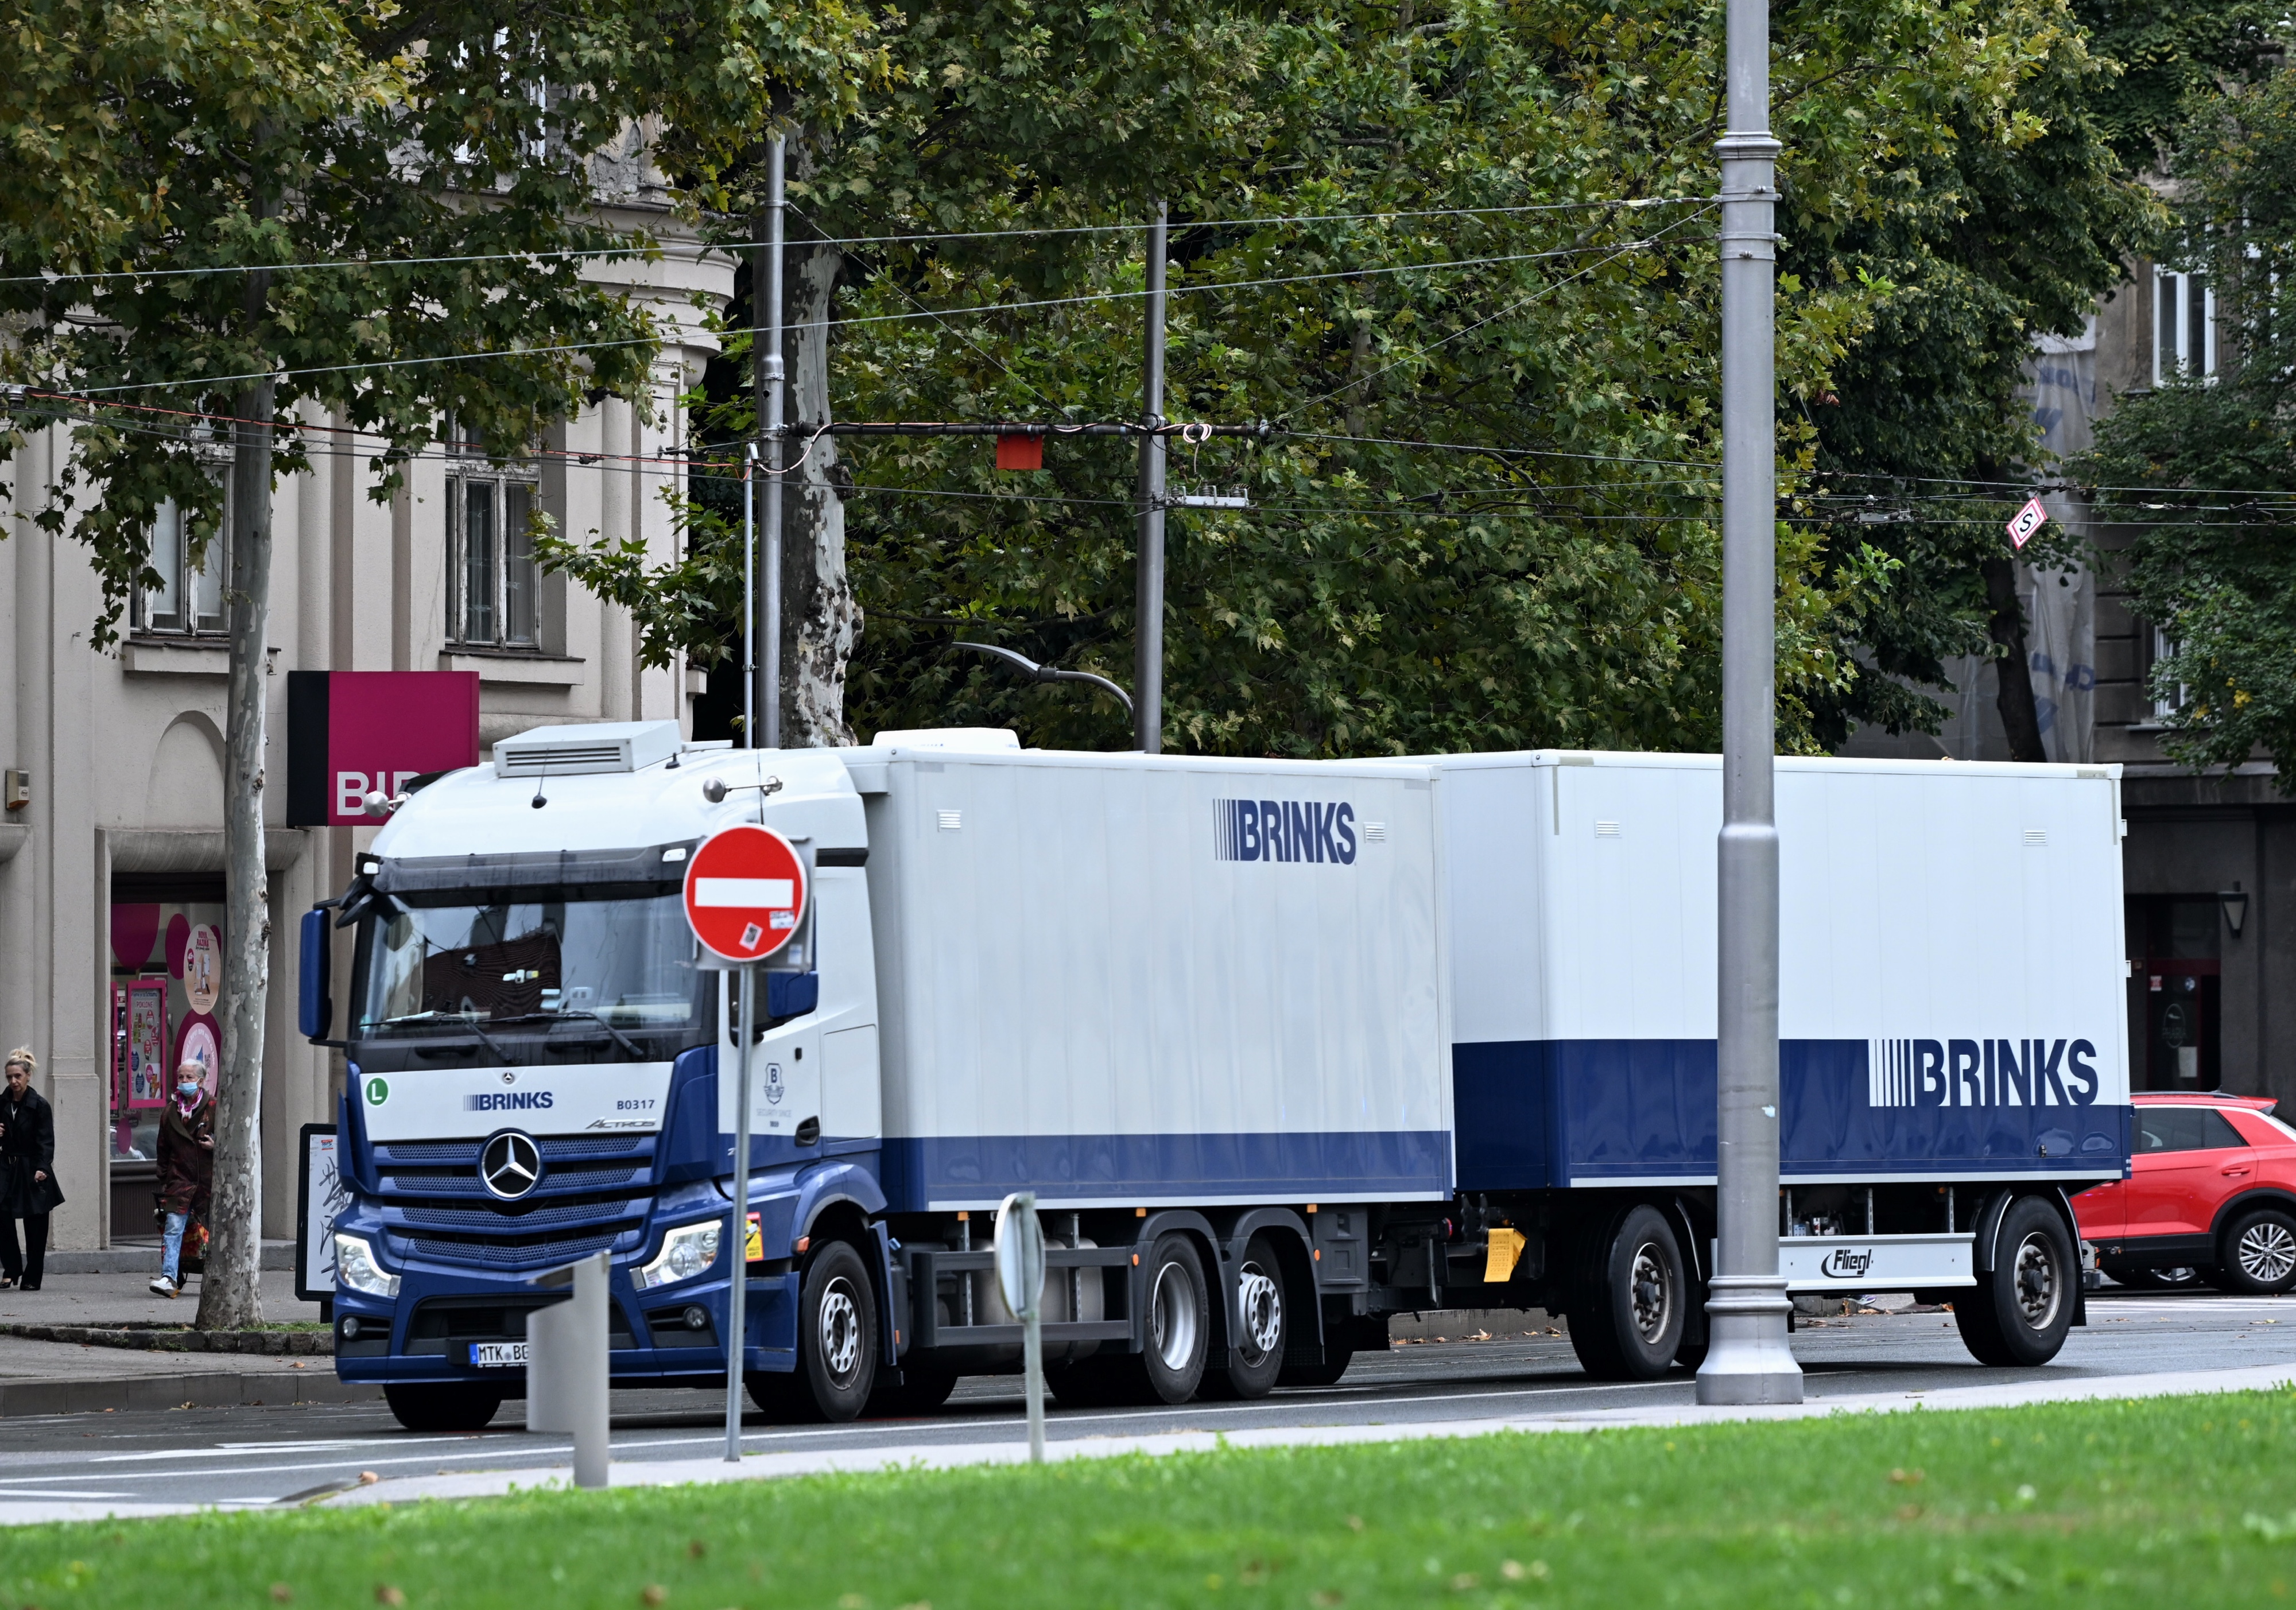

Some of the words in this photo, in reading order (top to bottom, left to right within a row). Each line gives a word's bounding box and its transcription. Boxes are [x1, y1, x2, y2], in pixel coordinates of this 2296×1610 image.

[2020, 513, 2033, 532] S
[1238, 800, 1356, 865] BRINKS
[771, 1068, 777, 1083] B
[1913, 1039, 2099, 1106] BRINKS
[371, 1083, 383, 1101] L
[479, 1091, 553, 1111] BRINKS
[617, 1100, 654, 1110] B0317
[1833, 1249, 1872, 1275] Fliegl
[478, 1346, 503, 1361] MTK
